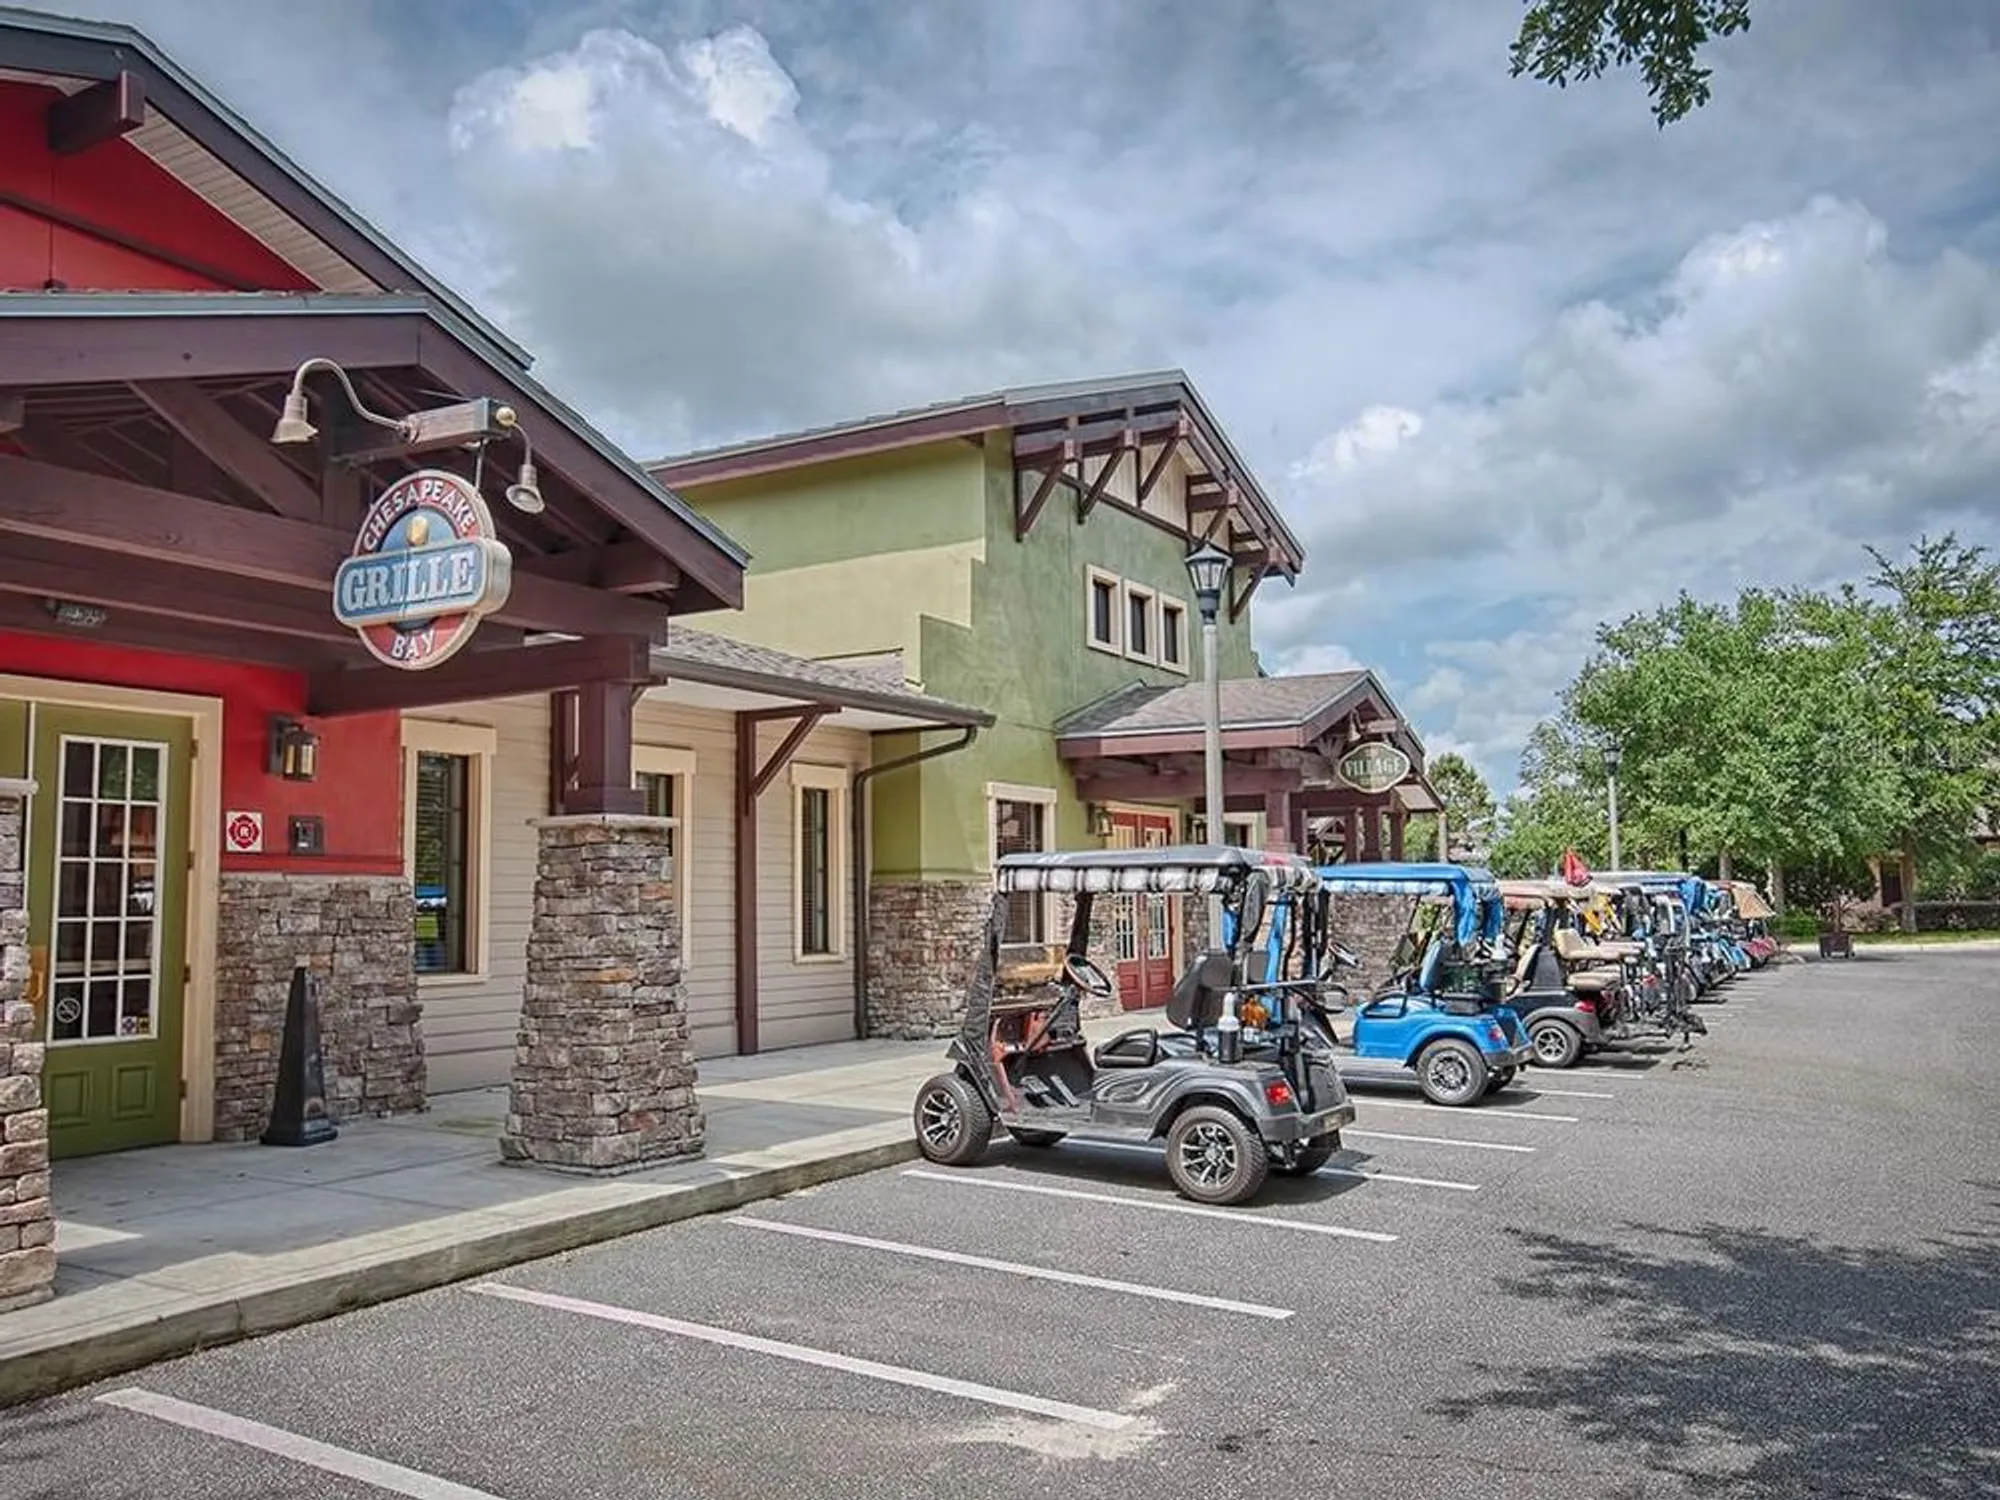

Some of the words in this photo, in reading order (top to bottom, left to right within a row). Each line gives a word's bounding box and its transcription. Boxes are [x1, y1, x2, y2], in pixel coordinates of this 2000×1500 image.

[363, 479, 477, 551] CHESAPEAKE
[342, 550, 475, 611] GRILLE
[391, 626, 436, 661] BAY
